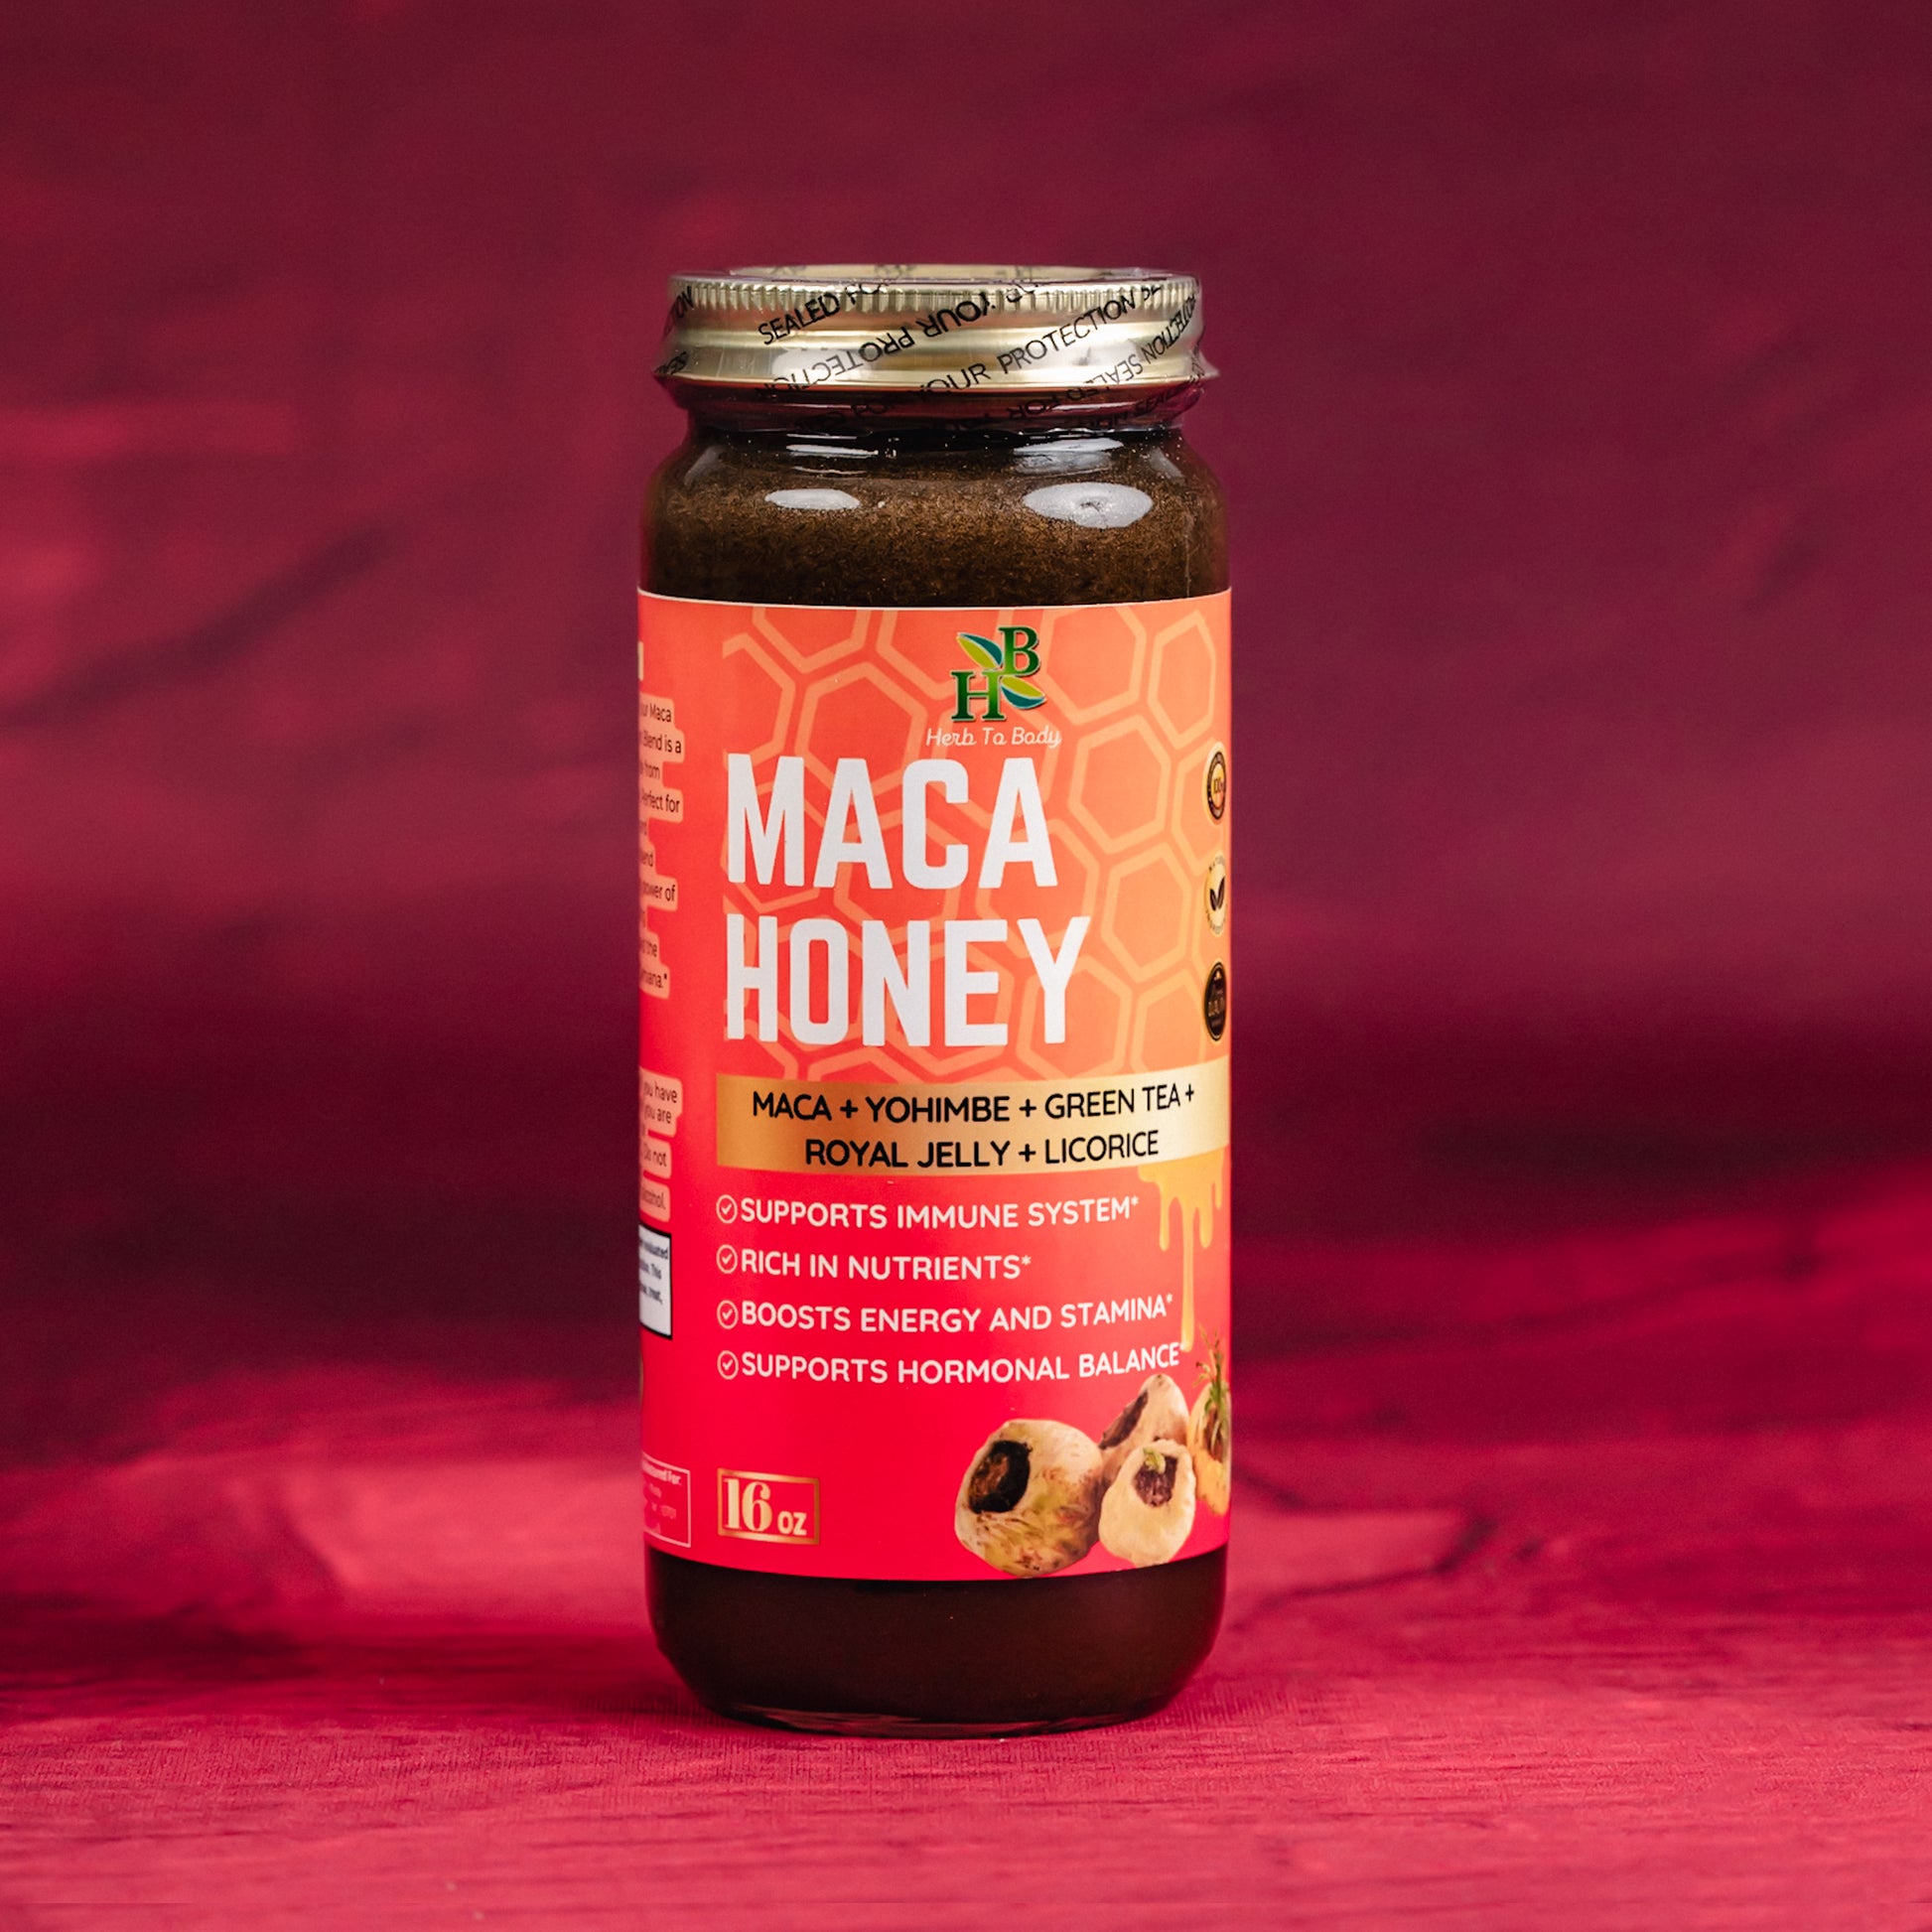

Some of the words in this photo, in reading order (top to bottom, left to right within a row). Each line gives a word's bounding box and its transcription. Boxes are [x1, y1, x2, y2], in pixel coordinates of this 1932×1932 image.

[759, 292, 841, 345] SEALED
[915, 292, 996, 338] YOUR
[997, 288, 1137, 374] PROTECTION
[675, 741, 682, 754] a
[926, 728, 976, 747] Herb
[982, 728, 1007, 745] To
[1012, 725, 1062, 749] Body
[665, 794, 680, 813] for
[728, 754, 1058, 889] MACA
[665, 884, 676, 901] of
[727, 913, 1091, 1046] HONEY
[657, 1107, 672, 1124] are
[753, 1091, 832, 1121] MACA
[839, 1099, 859, 1119] +
[865, 1096, 1011, 1123] YOHIMBE
[1019, 1099, 1036, 1118] +
[1044, 1088, 1135, 1120] GREEN
[1142, 1083, 1181, 1111] TEA
[805, 1139, 908, 1168] ROYAL
[917, 1141, 1011, 1169] JELLY
[1019, 1144, 1036, 1162] +
[1045, 1130, 1159, 1165] LICORICE
[741, 1197, 888, 1229] SUPPORTS
[897, 1203, 1019, 1229] IMMUNE
[742, 1248, 800, 1277] RICH
[810, 1254, 838, 1278] IN
[742, 1301, 851, 1331] BOOSTS
[861, 1308, 981, 1332] ENERGY
[989, 1306, 1052, 1331] AND
[742, 1351, 889, 1384] SUPPORTS
[897, 1356, 1069, 1384] HORMONAL
[724, 1478, 772, 1532] 16
